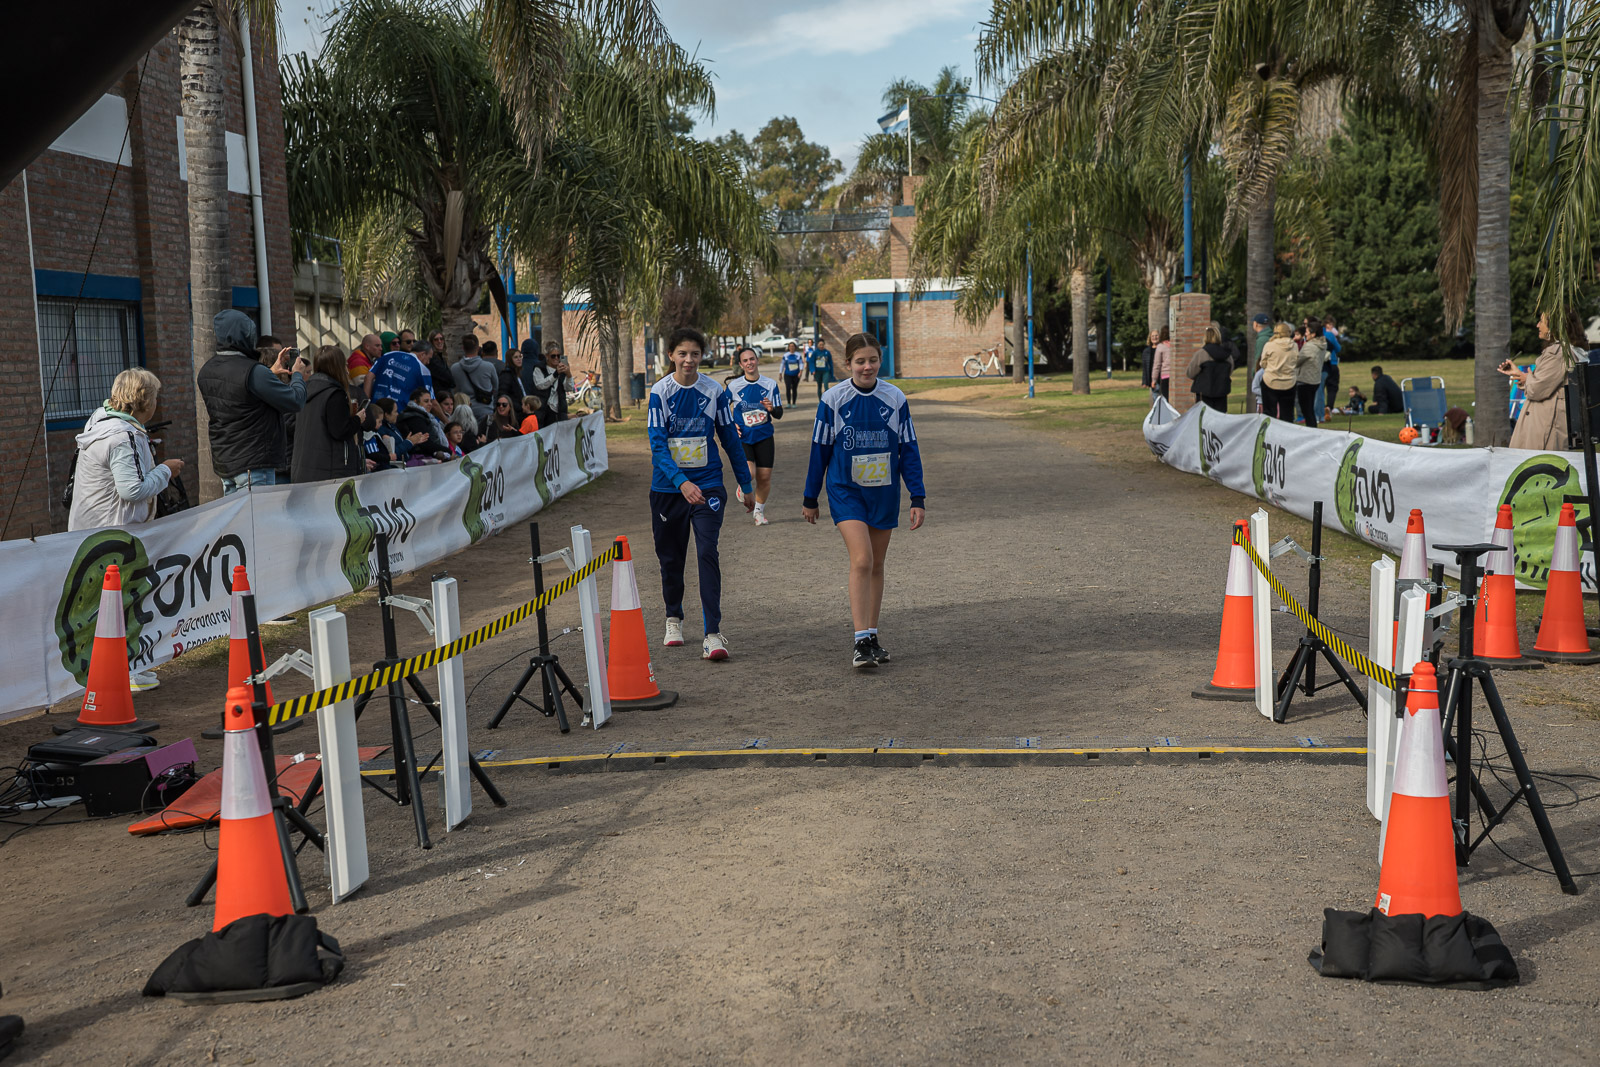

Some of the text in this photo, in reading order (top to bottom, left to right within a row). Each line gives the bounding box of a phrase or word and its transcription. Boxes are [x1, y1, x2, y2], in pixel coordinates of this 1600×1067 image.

[669, 413, 676, 433] 3
[746, 412, 766, 425] 518
[843, 425, 855, 451] 3
[669, 445, 704, 461] 724
[856, 462, 889, 480] 723
